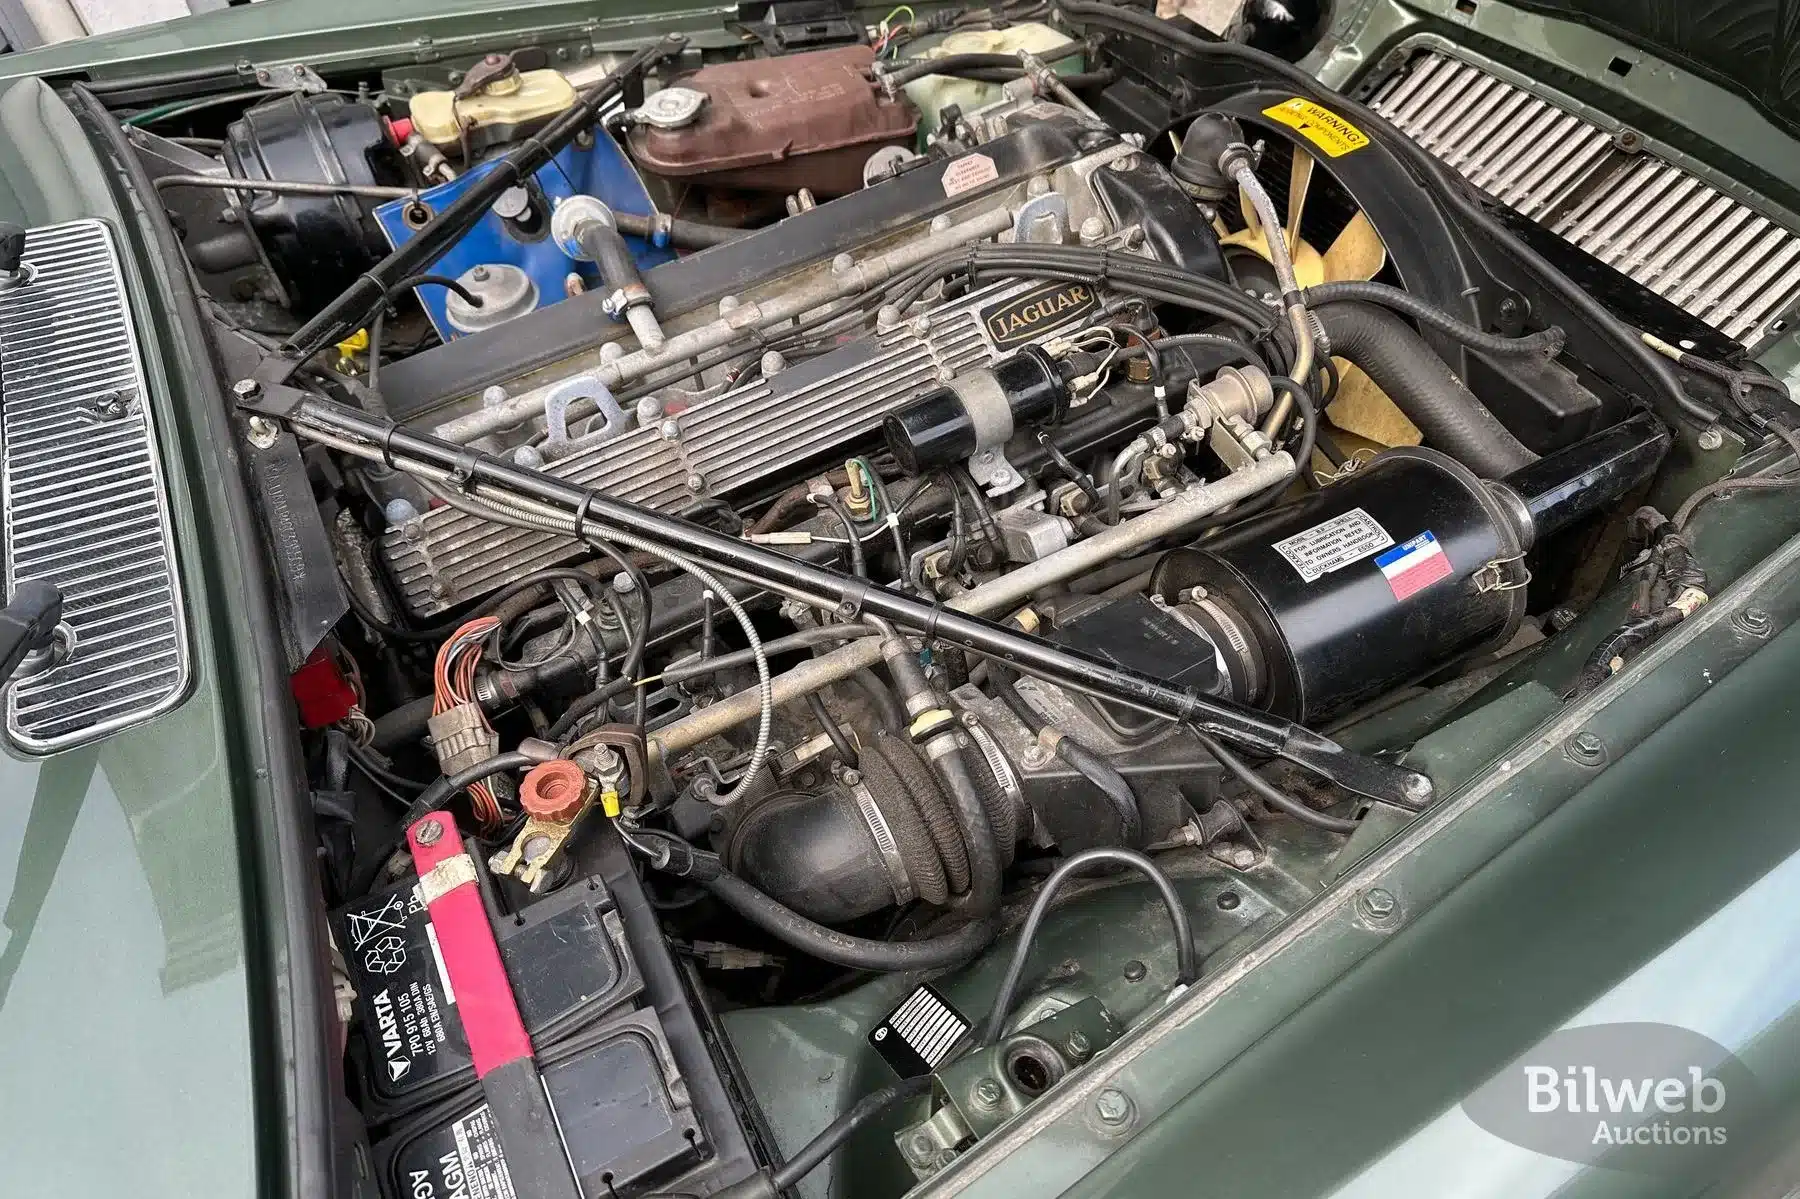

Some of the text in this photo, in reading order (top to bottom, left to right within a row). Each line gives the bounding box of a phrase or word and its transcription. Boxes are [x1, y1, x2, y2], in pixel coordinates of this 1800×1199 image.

[1307, 107, 1365, 145] WARNING!
[996, 286, 1089, 338] JAGUAR
[1293, 520, 1361, 553] FOR LUBRICATION AND
[1304, 528, 1363, 557] INFORMATION REFER
[1305, 531, 1375, 566] TO OWNERS HANDBOOK
[1401, 534, 1427, 551] UNIPART
[1312, 542, 1374, 574] DUCKHAMS ESSO
[397, 992, 410, 1013] 105
[409, 981, 420, 995] DIN
[373, 988, 403, 1058] VARTA
[403, 1014, 418, 1034] 915
[425, 1039, 437, 1055] 12V
